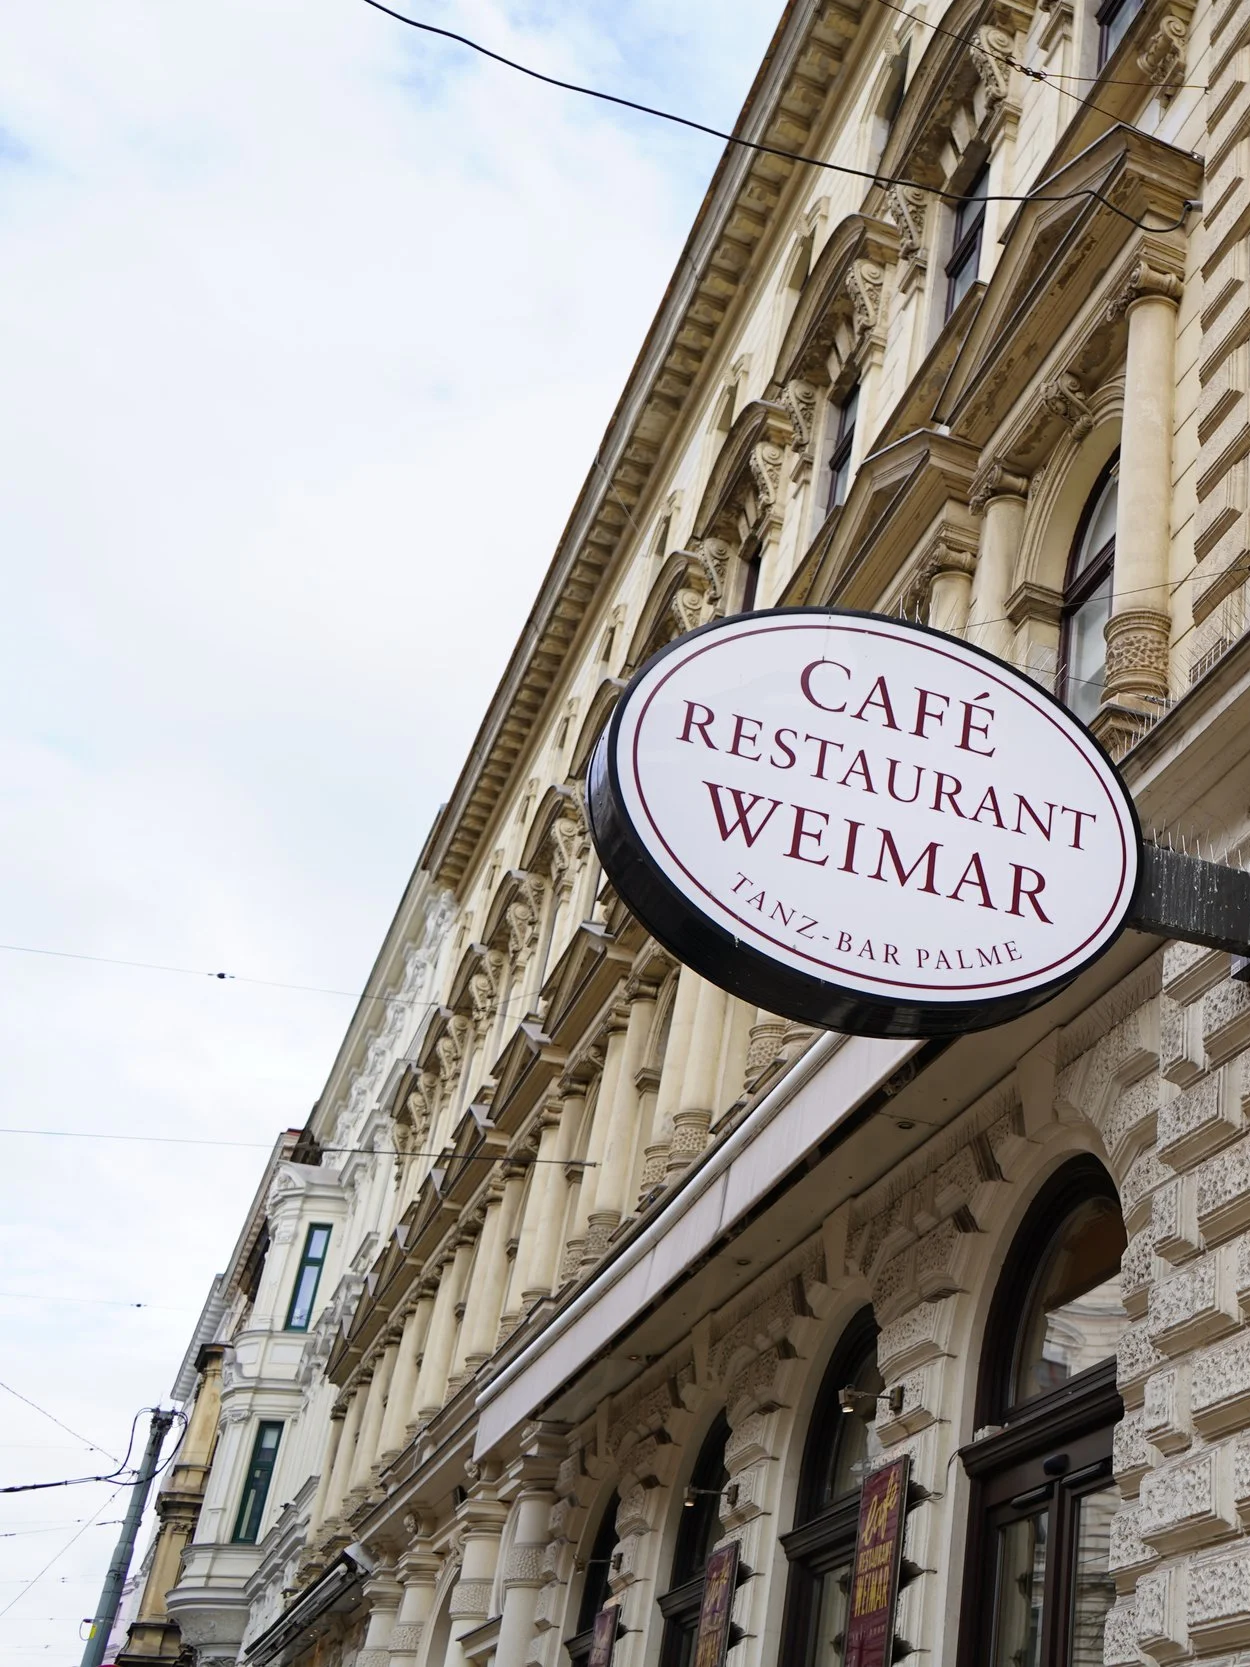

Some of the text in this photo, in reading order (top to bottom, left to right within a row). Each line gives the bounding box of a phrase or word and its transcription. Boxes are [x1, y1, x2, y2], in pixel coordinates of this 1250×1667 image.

[800, 656, 997, 758] CAFÉ
[676, 699, 1097, 851] RESTAURANT
[701, 780, 1054, 925] WEIMAR
[730, 870, 1023, 970] TANZ-BAR PALME
[853, 1565, 890, 1618] WEIMAR
